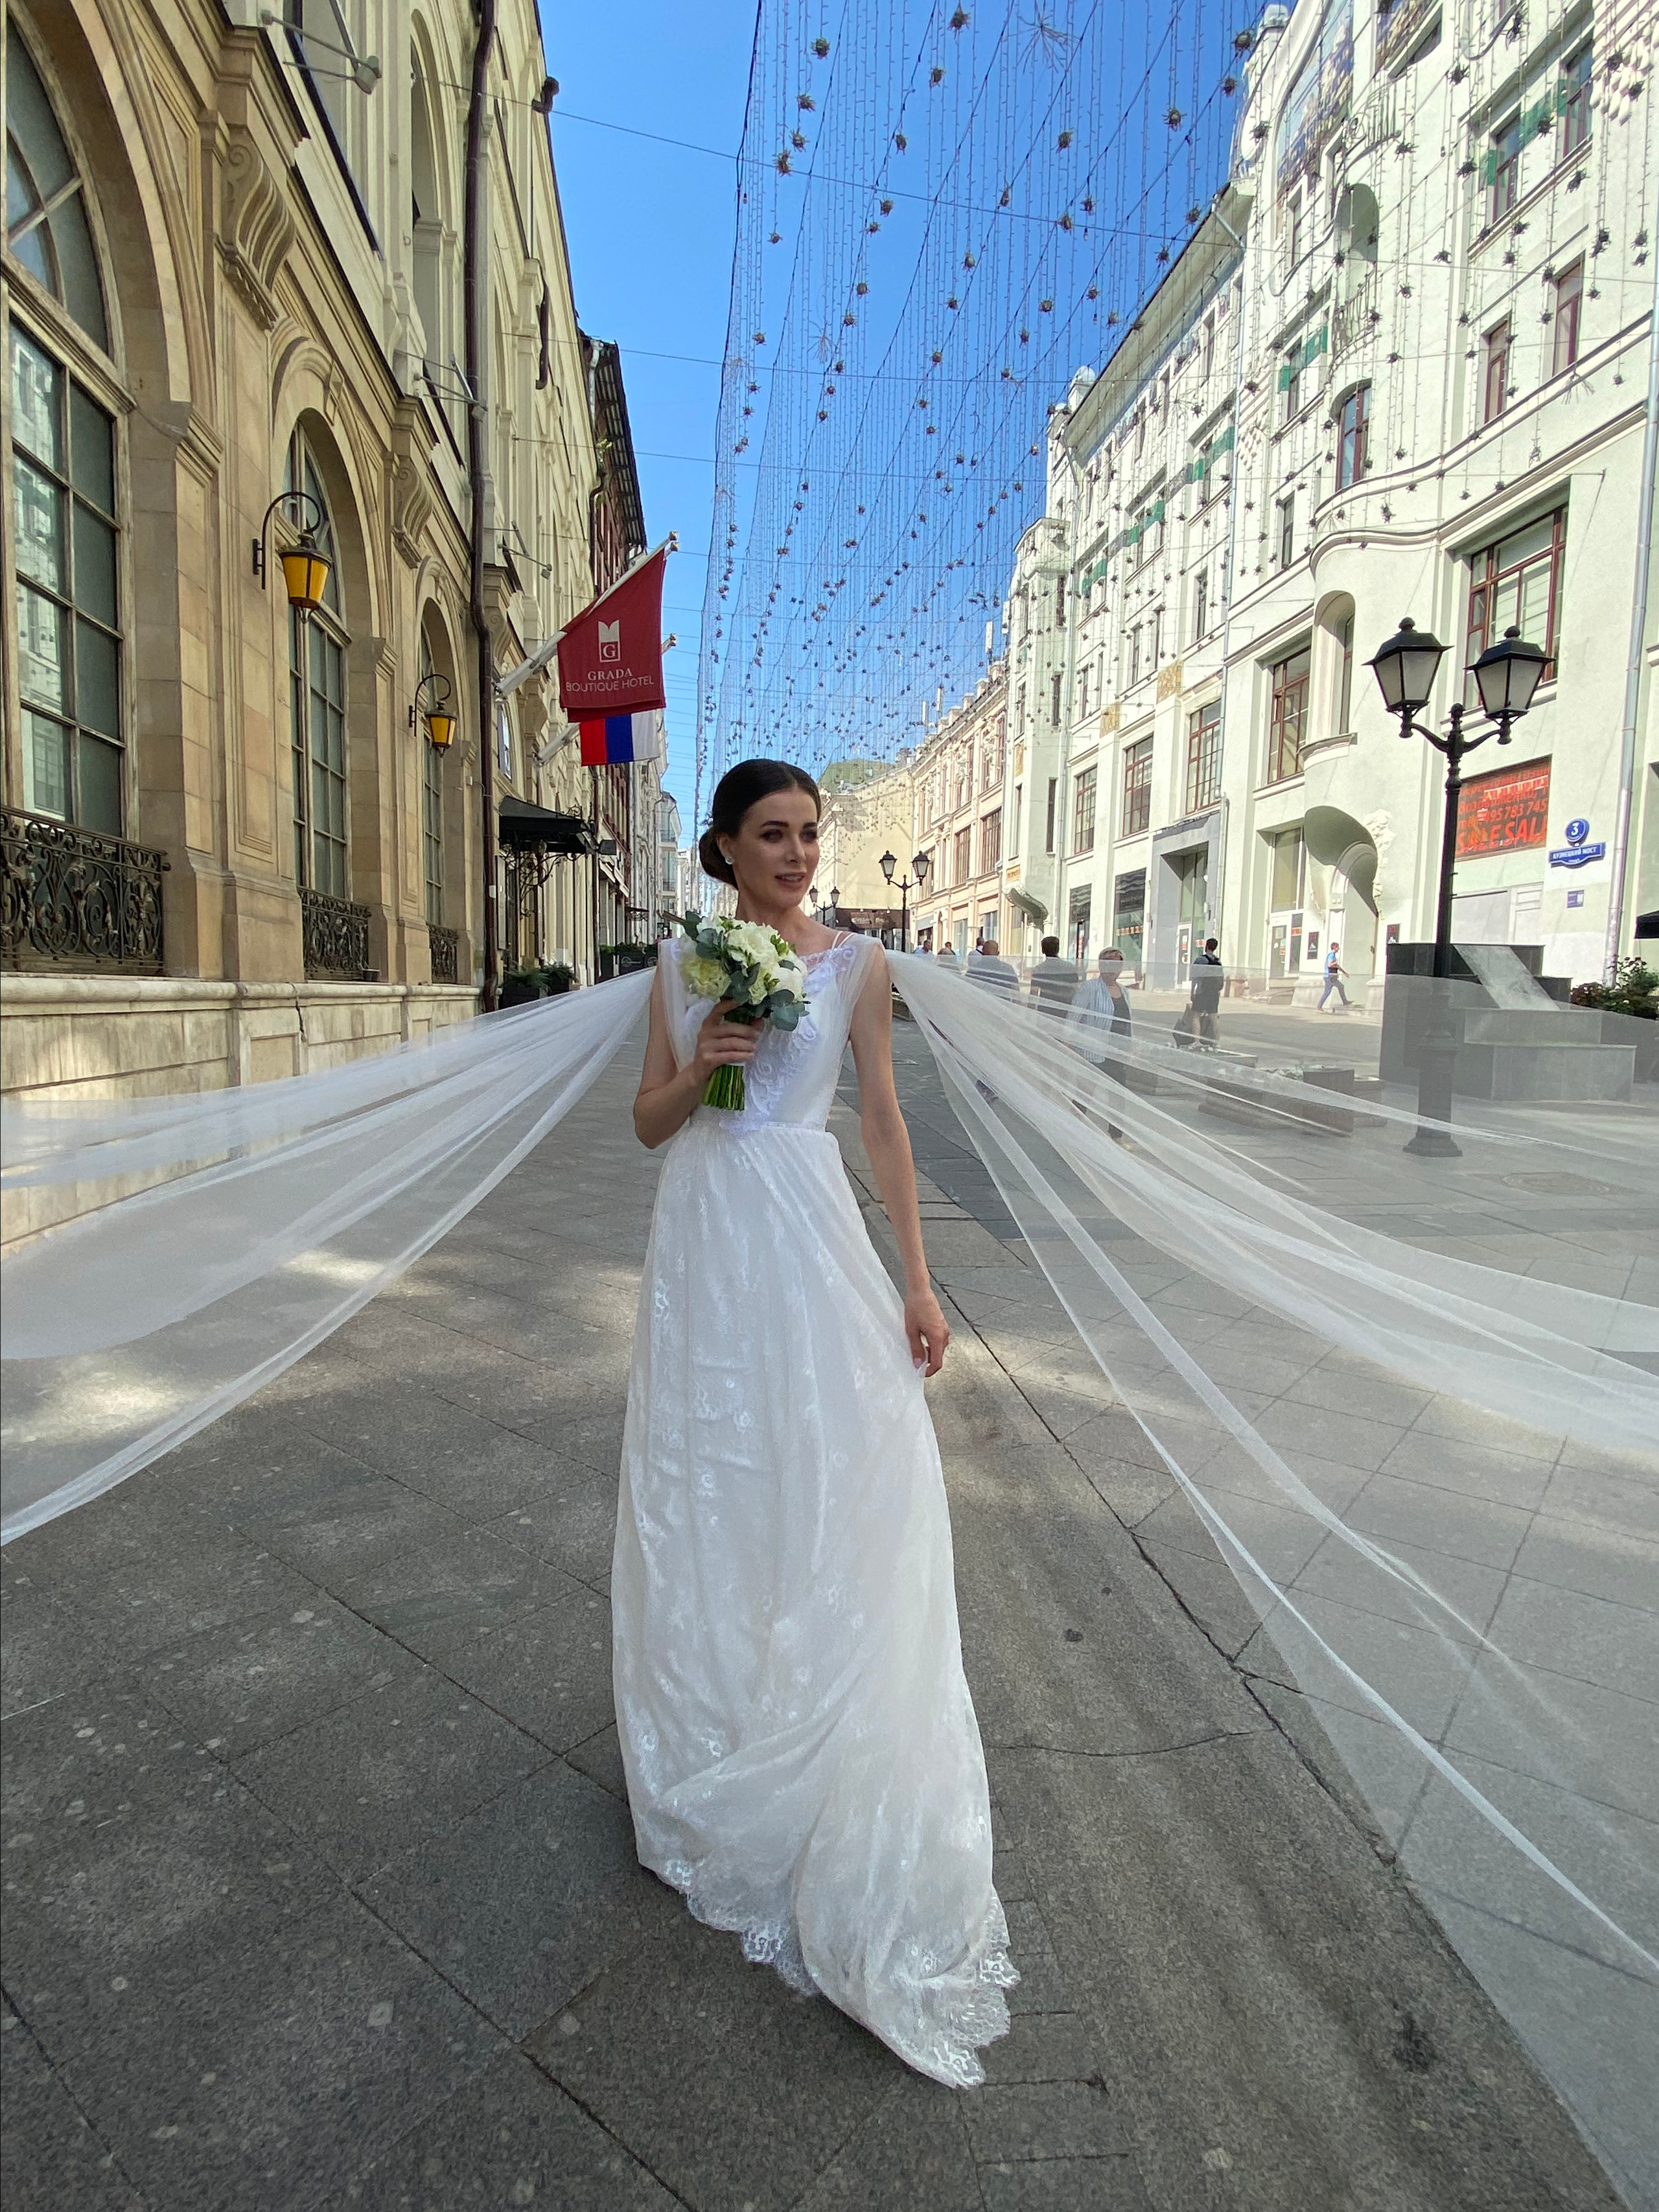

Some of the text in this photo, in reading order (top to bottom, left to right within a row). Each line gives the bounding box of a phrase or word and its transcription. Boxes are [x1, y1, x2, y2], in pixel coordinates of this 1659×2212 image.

[603, 645, 616, 658] G
[588, 668, 632, 681] GRADA
[566, 675, 655, 692] BOUTIQUE HOTEL
[1571, 822, 1579, 835] 3
